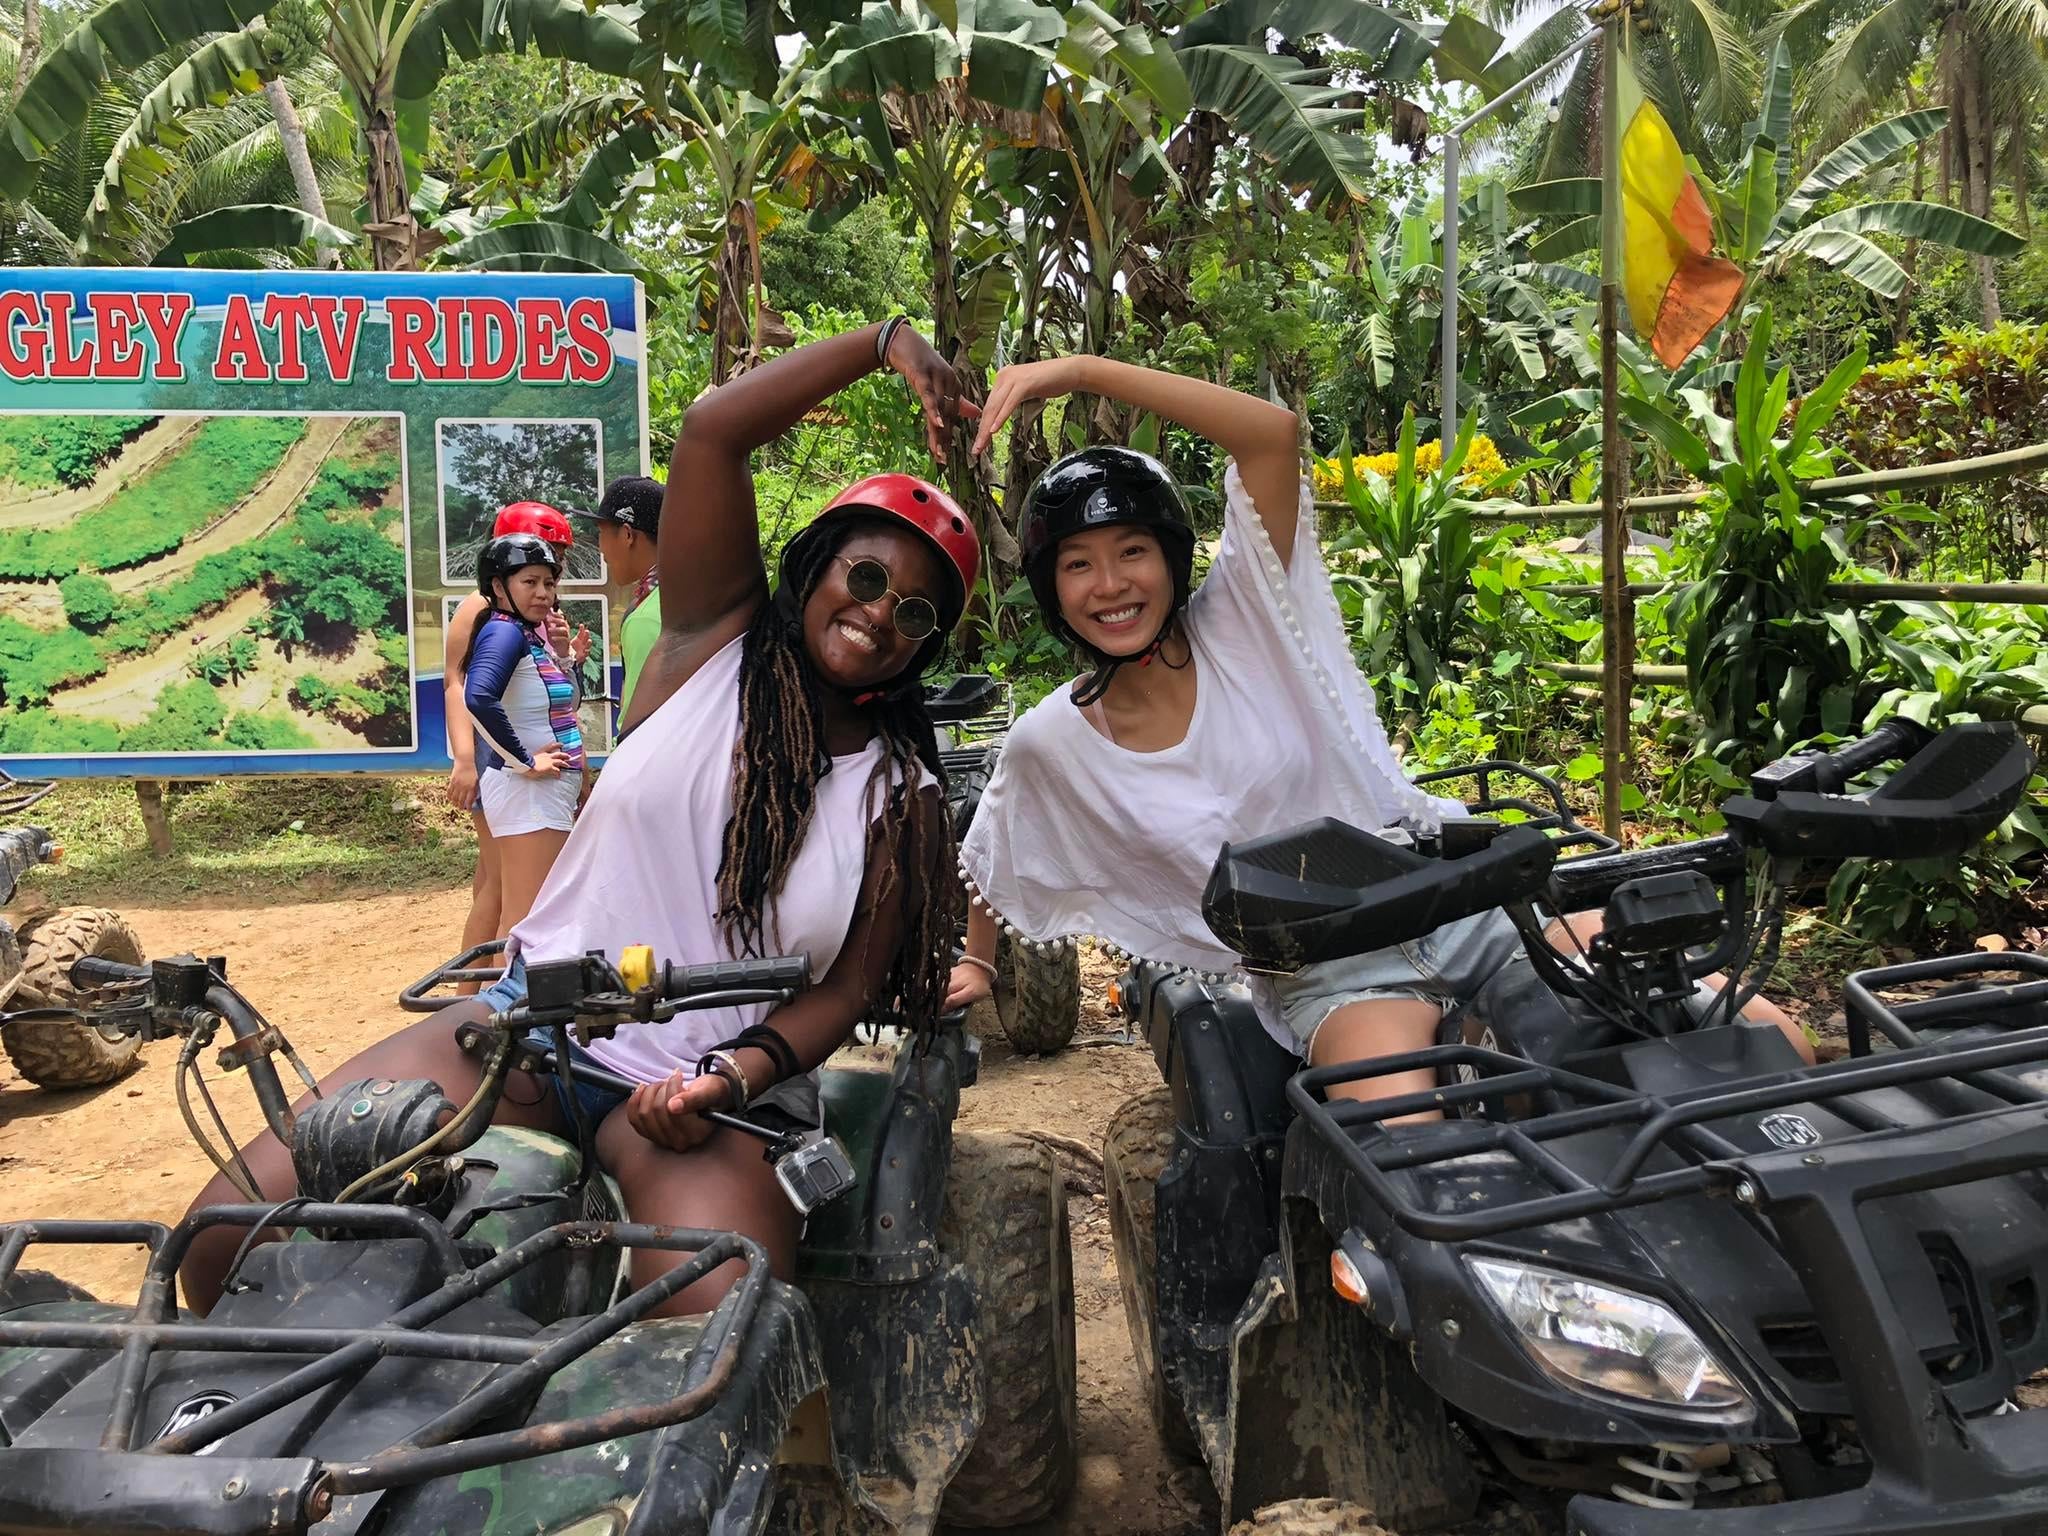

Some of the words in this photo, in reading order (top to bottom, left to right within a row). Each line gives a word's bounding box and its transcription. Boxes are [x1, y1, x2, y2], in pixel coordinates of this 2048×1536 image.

[0, 290, 191, 382] GLEY
[214, 294, 366, 382] ATV
[385, 297, 613, 385] RIDES
[1090, 506, 1118, 515] HELMO
